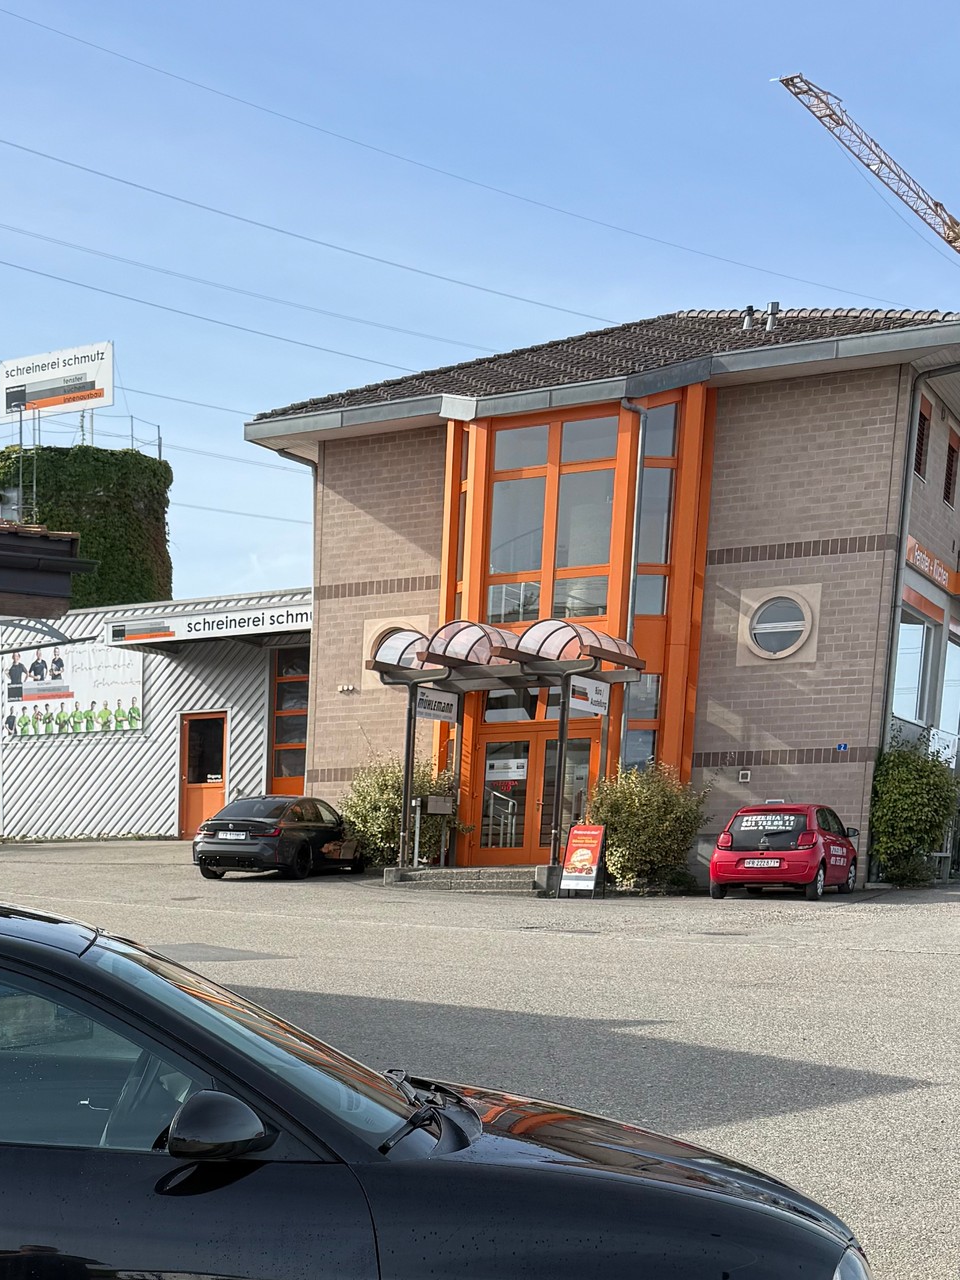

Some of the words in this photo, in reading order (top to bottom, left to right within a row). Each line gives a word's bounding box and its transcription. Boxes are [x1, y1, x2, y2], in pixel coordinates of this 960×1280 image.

[5, 358, 60, 378] schreinerei
[62, 350, 105, 368] schmutz
[63, 376, 83, 384] fenster
[63, 391, 102, 403] innenausbau
[187, 613, 265, 633] schreinerei
